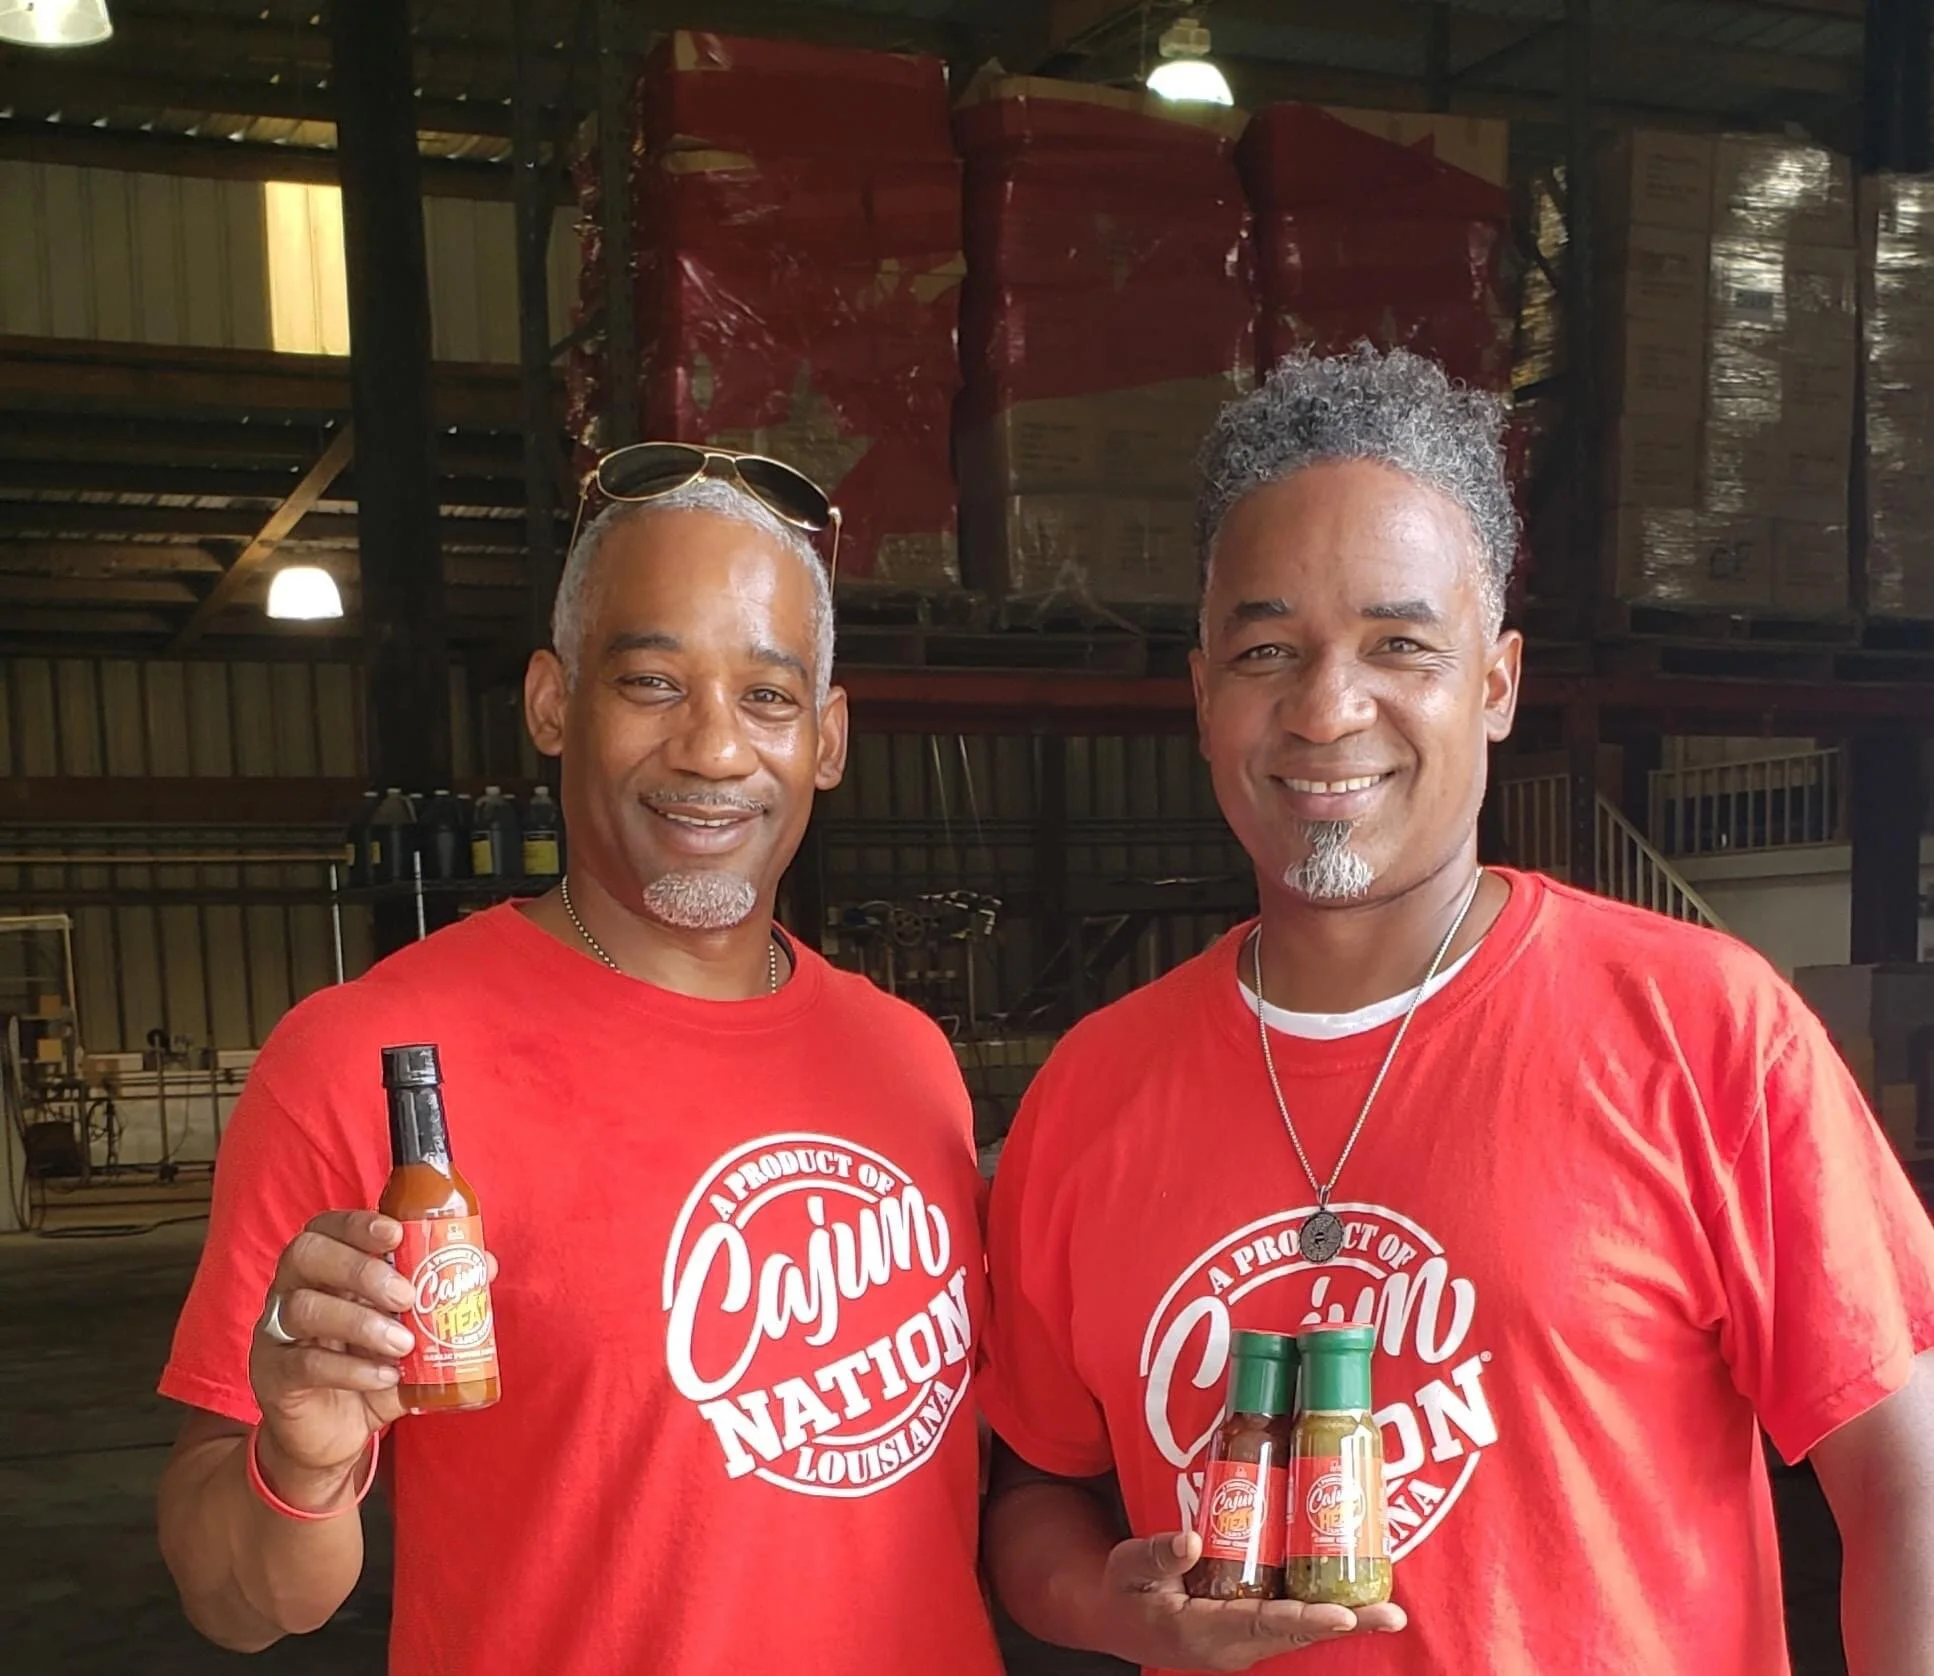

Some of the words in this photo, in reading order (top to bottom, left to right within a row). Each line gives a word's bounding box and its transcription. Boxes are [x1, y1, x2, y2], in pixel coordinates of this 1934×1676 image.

[709, 1194, 737, 1221] A
[723, 1149, 853, 1201] PRODUCT
[857, 1165, 895, 1195] OF
[665, 1184, 951, 1402] Cajun
[1208, 1266, 1235, 1295] A
[1231, 1222, 1380, 1276] PROCT
[1377, 1233, 1418, 1271] OF
[698, 1268, 972, 1480] NATION
[794, 1381, 955, 1485] LOUISIANA
[1217, 1509, 1256, 1534] HEA
